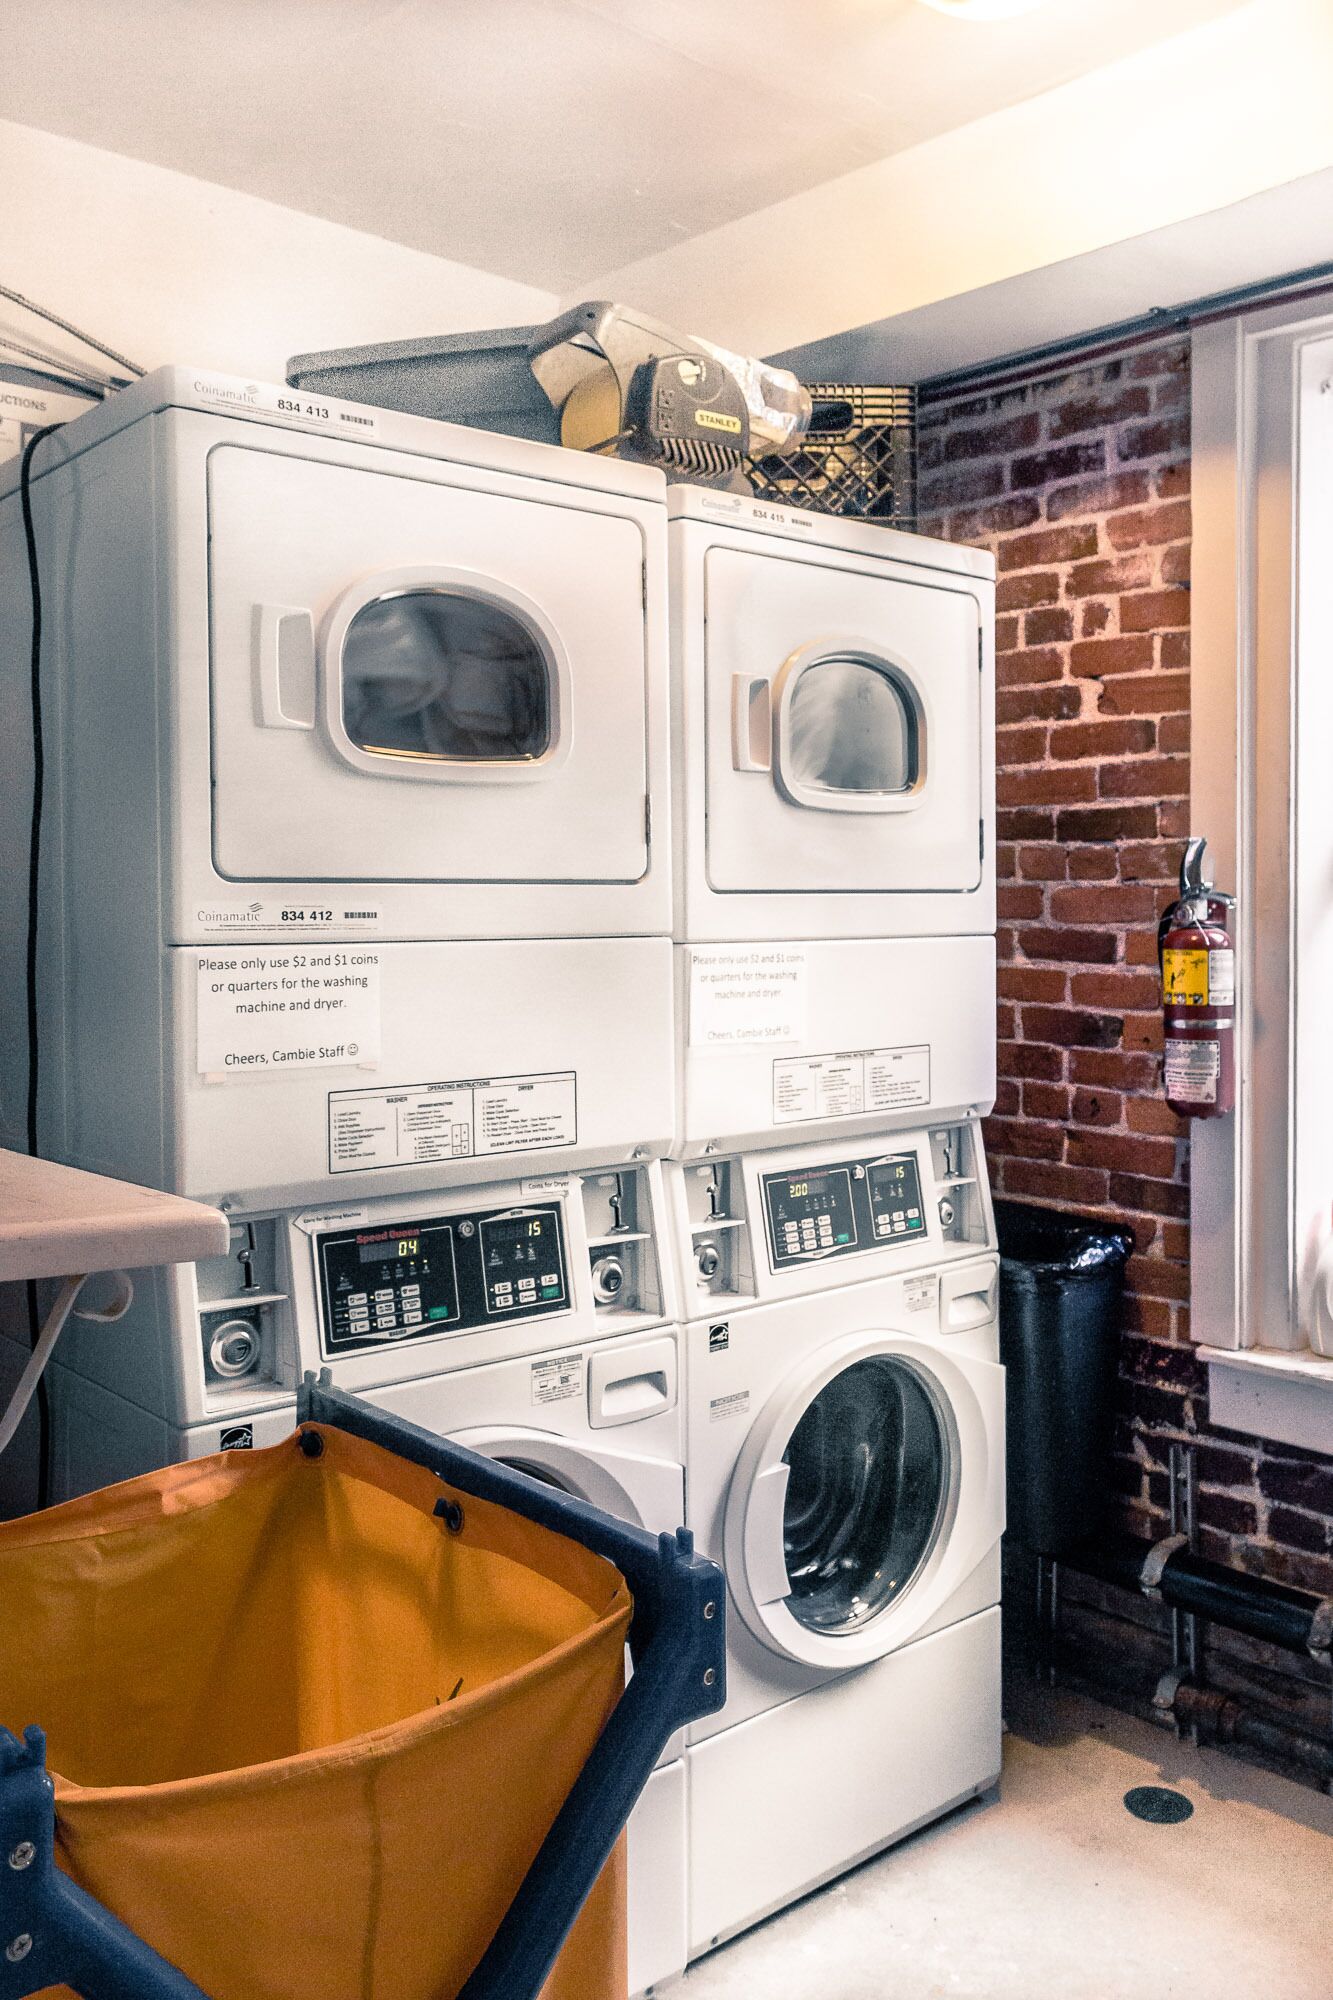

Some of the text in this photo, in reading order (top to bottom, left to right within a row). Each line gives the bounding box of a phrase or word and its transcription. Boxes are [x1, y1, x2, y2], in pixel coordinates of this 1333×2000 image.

[194, 381, 256, 404] Coinamatic
[277, 399, 300, 412] 834
[306, 405, 329, 419] 413
[699, 413, 739, 429] STANLEY
[752, 509, 767, 519] 834
[197, 910, 333, 922] Coinamatic 834 412
[198, 953, 379, 971] Please only use $2 and $1 coins
[692, 955, 716, 964] Please
[761, 954, 774, 963] and
[211, 975, 368, 994] or quarters for the washing
[710, 973, 741, 983] quarters
[743, 971, 753, 980] for
[755, 972, 767, 980] the
[769, 971, 797, 981] washing
[714, 990, 745, 999] machine
[747, 990, 761, 998] and
[235, 998, 347, 1014] machine and dryer.
[224, 1045, 345, 1066] Cheers, Cambie Staff
[427, 1081, 490, 1091] OPERATING INSTRUCTIONS
[528, 1182, 543, 1190] Coins
[554, 1180, 569, 1188] Dryer
[528, 1221, 541, 1236] 15
[356, 1228, 420, 1245] Speed Queen
[398, 1240, 417, 1257] 04
